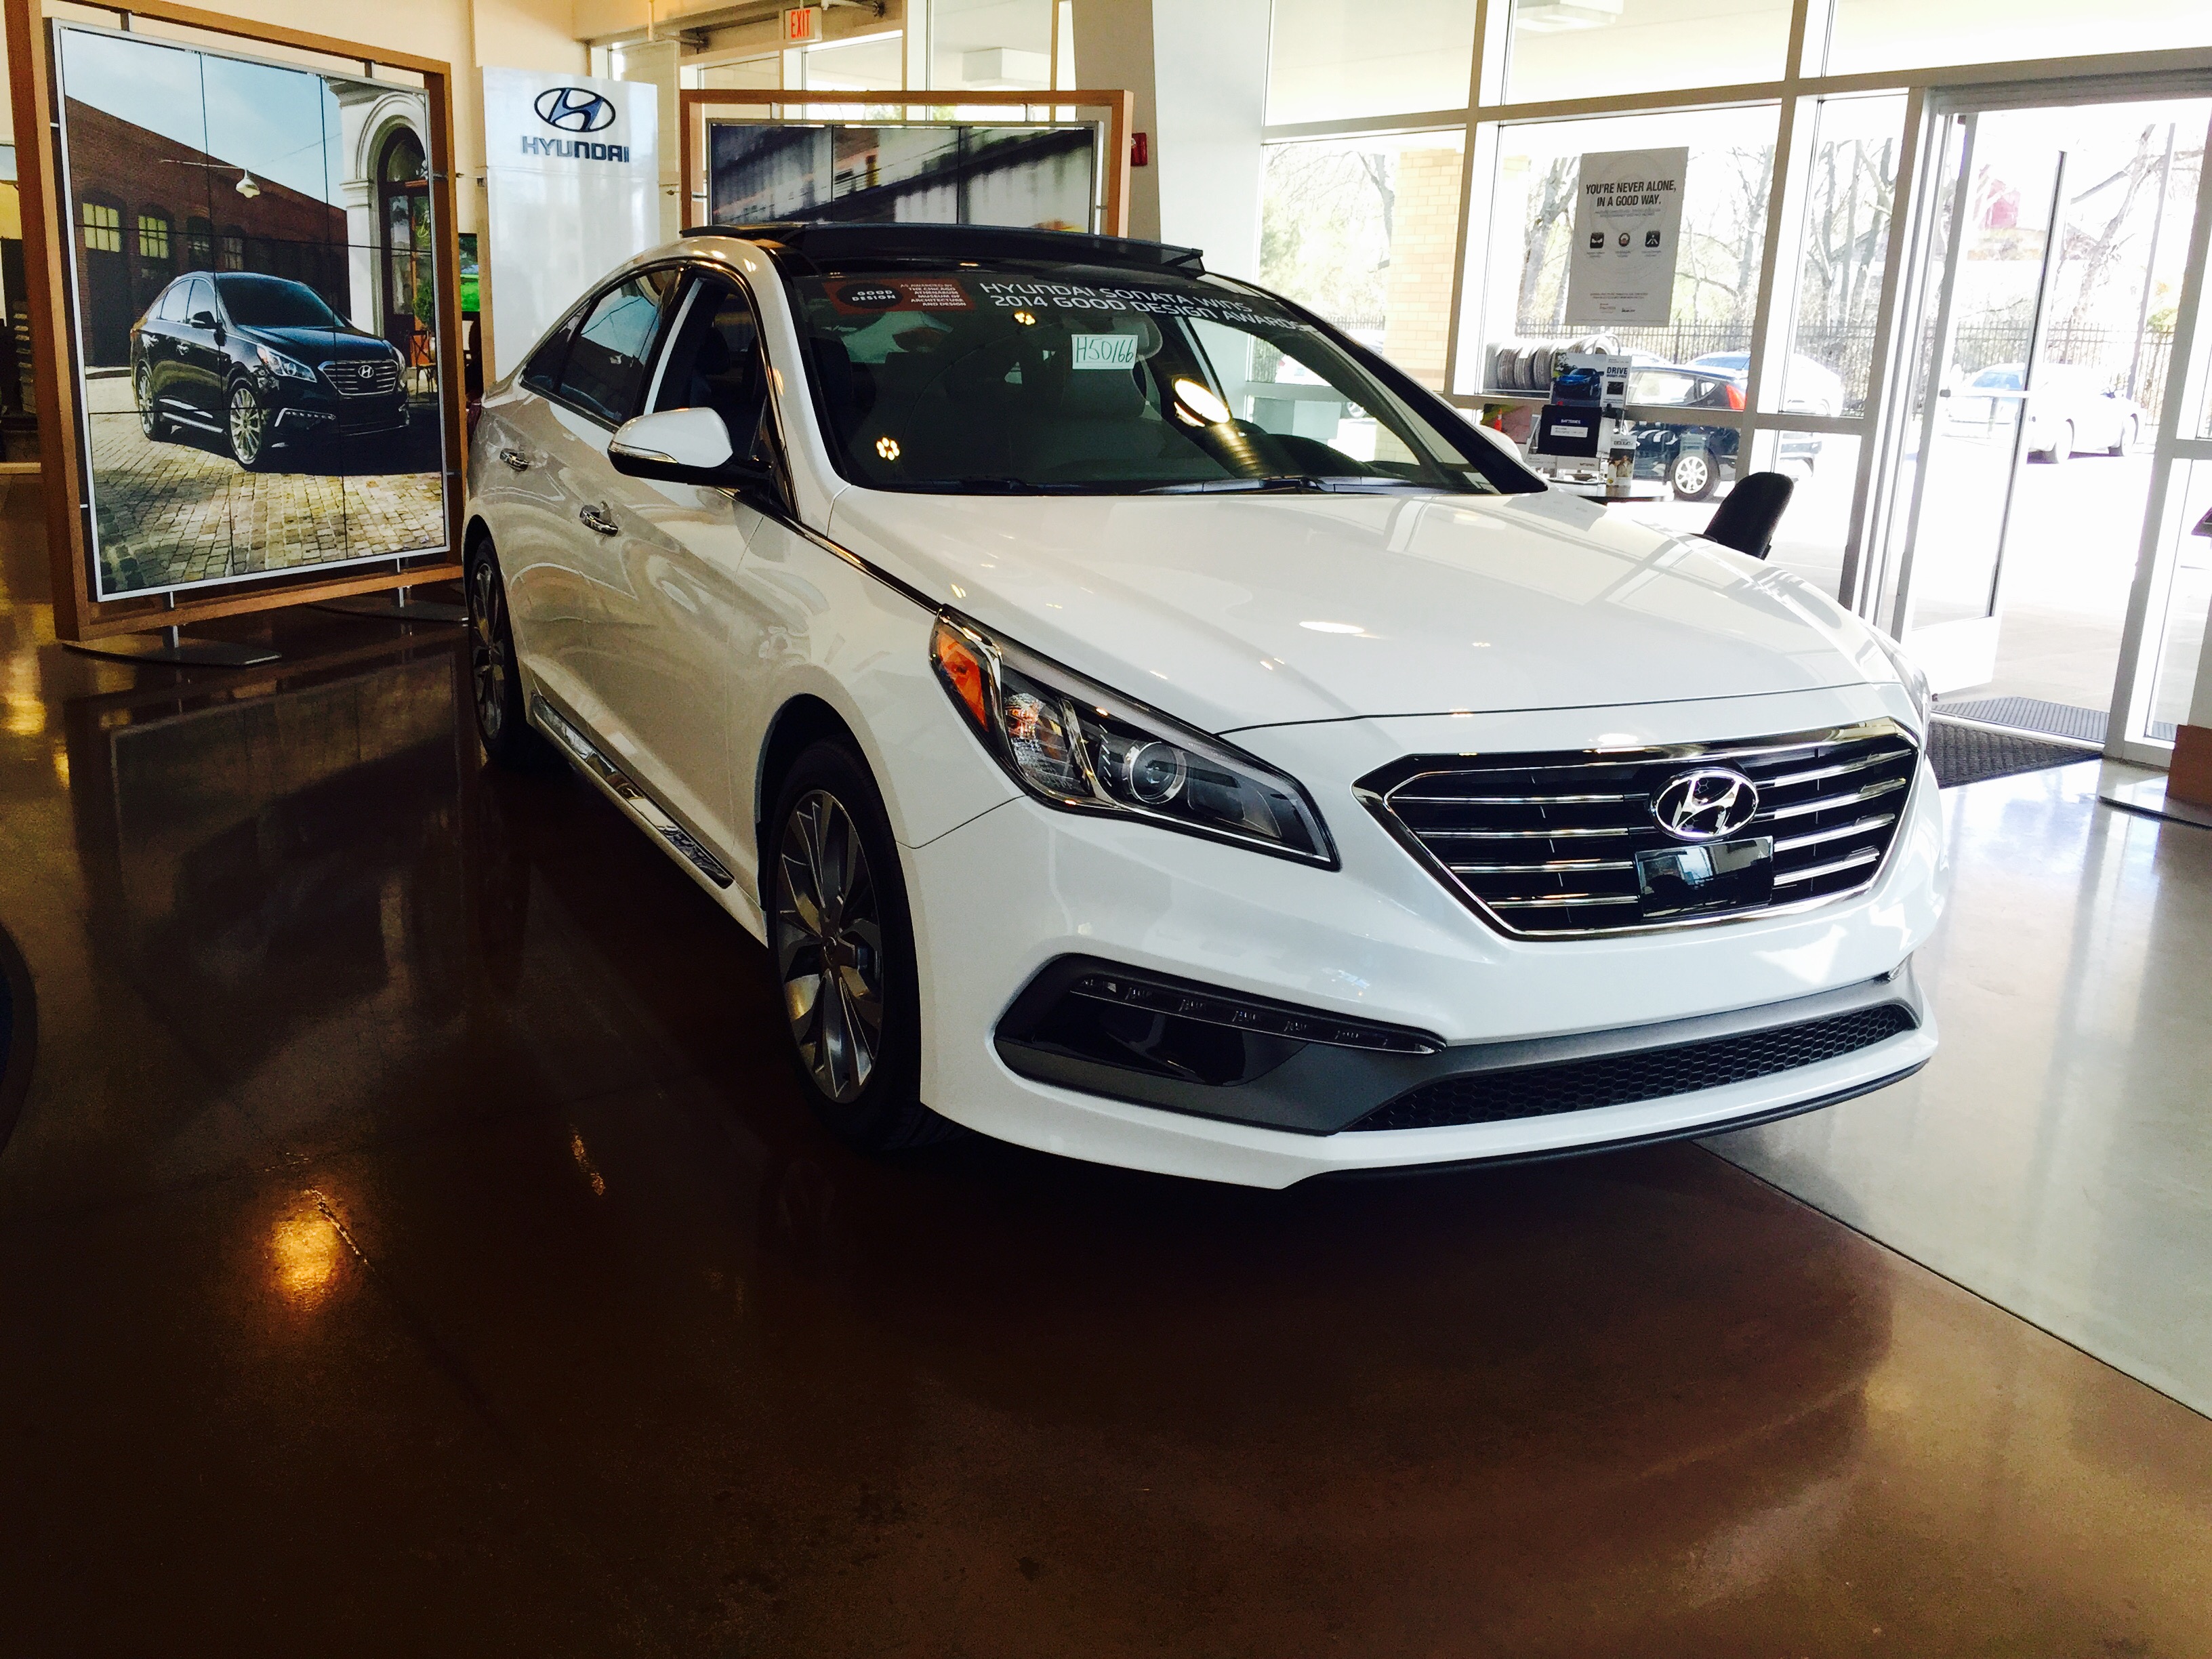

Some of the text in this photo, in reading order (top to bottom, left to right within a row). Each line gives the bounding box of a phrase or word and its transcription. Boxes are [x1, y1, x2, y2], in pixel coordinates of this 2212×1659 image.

[791, 9, 811, 38] EXIT
[522, 136, 630, 163] HYUNDAI
[1586, 180, 1677, 194] YOU'RE NEVER ALONE,
[1597, 194, 1661, 207] IN A GOOD WAY.
[980, 283, 1254, 312] HYUNDAI SONATA WINS
[990, 295, 1305, 331] 2014 GOOD DESIGN AWARDS
[1606, 367, 1628, 375] DRIVE
